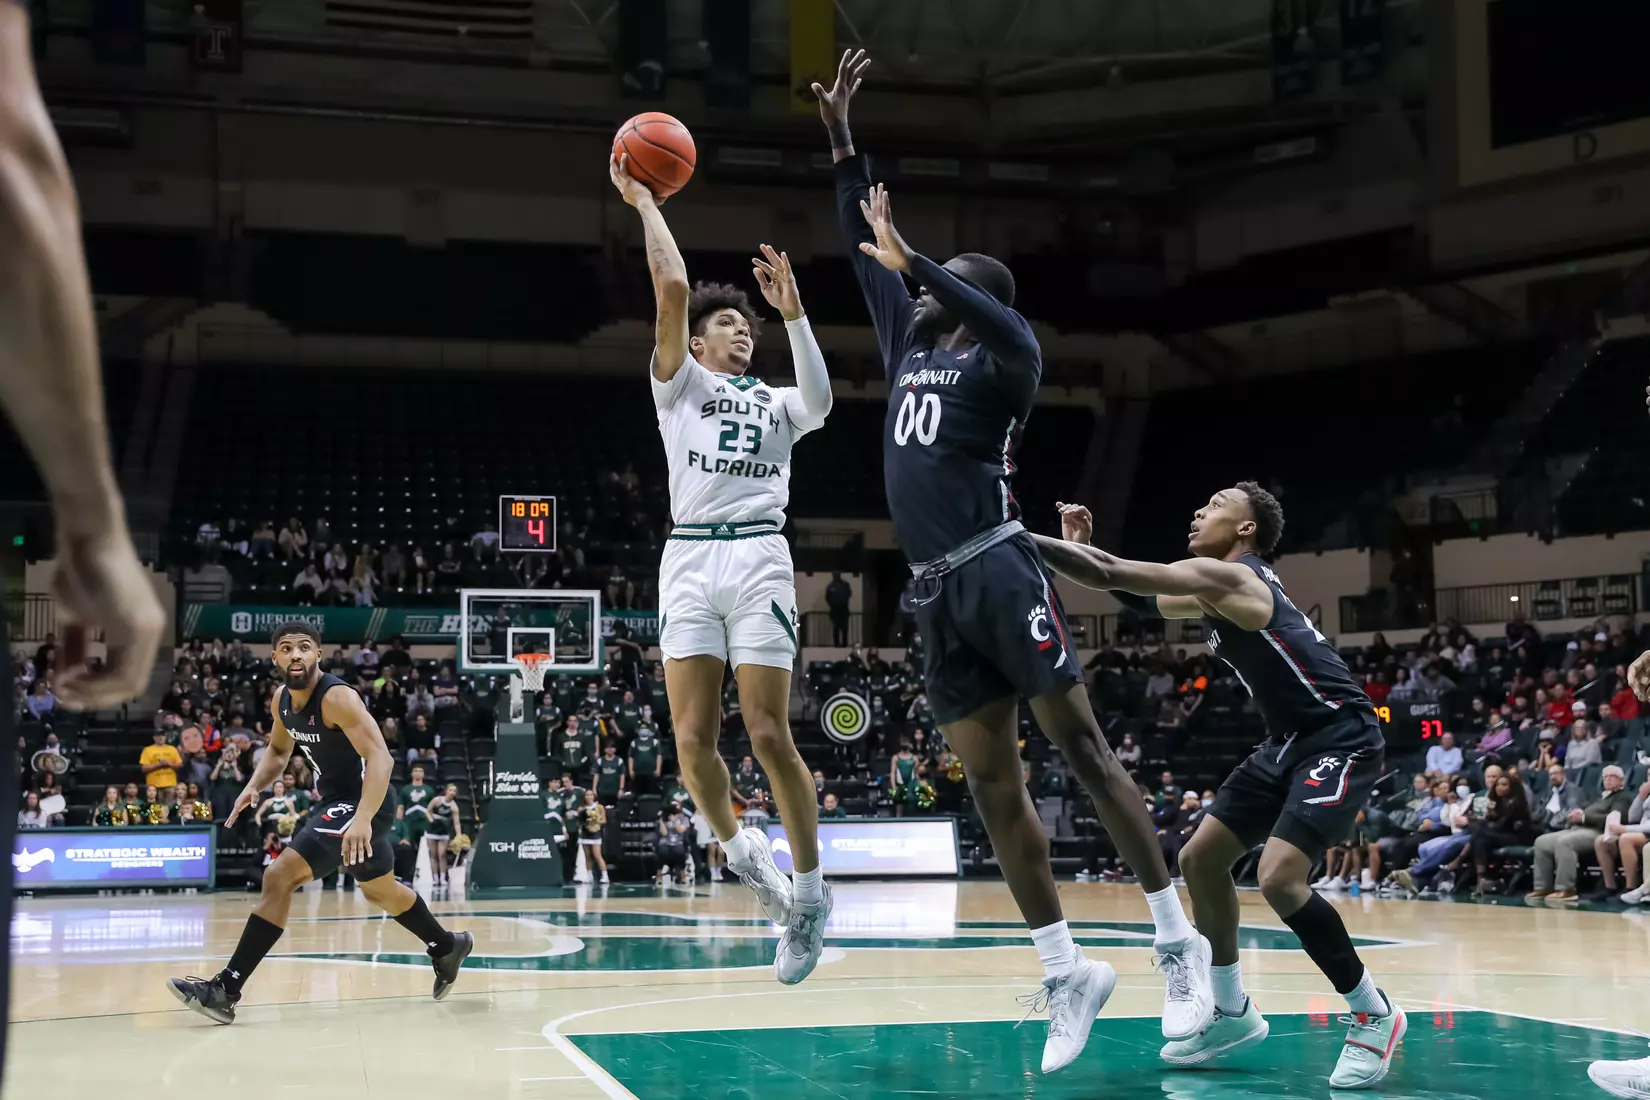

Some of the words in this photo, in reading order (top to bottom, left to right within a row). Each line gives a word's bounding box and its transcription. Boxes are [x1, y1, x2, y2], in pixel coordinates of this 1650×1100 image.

[701, 399, 780, 434] SOUTH
[894, 391, 942, 446] 00
[718, 419, 763, 456] 23
[688, 449, 781, 478] FLORIDA
[527, 519, 545, 544] 4
[254, 613, 325, 625] HERITAGE
[1410, 703, 1440, 716] GUEST
[1421, 719, 1443, 739] 37
[495, 771, 537, 782] Florida
[495, 782, 519, 793] Blue
[65, 848, 147, 859] STRATEGIC
[150, 847, 206, 857] WEALTH
[489, 842, 515, 852] TGH
